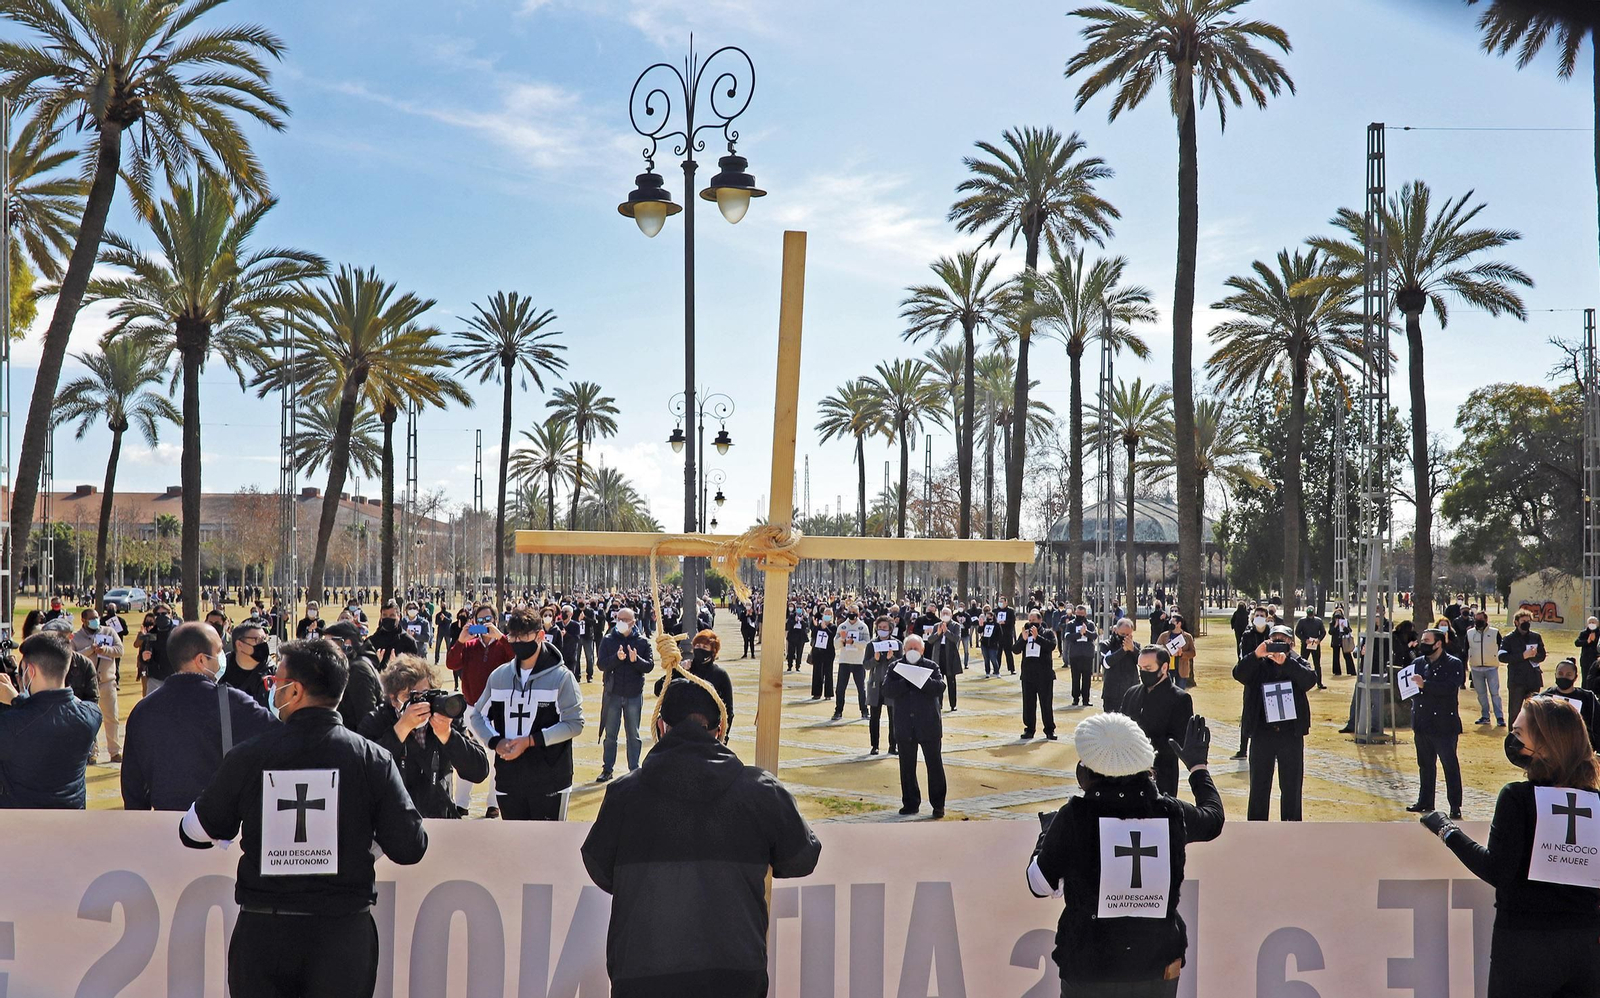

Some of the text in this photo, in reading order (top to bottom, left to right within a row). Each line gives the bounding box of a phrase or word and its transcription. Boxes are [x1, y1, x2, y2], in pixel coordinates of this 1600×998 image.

[1541, 842, 1598, 855] MI NEGOCIO
[283, 858, 329, 866] AUTONOMO
[1547, 854, 1589, 866] SE MUERE
